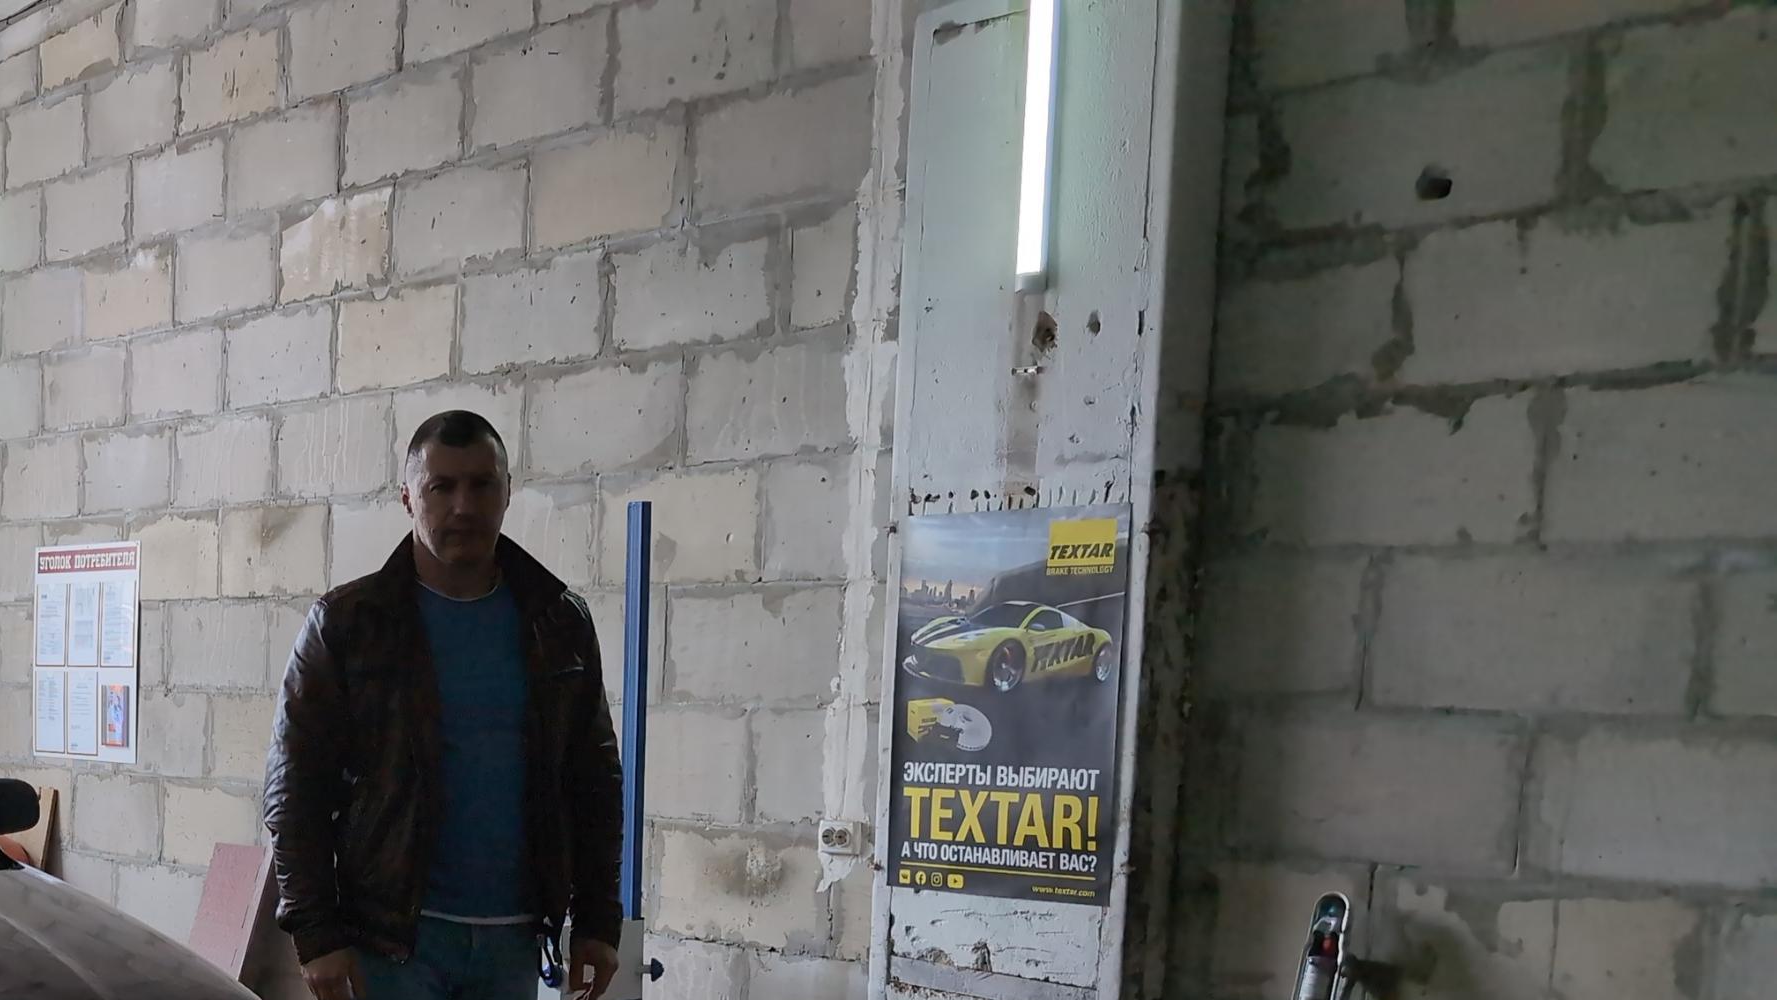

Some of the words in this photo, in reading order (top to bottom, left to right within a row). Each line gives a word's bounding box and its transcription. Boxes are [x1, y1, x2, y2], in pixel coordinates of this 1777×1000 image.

[39, 555, 72, 570] УГОЛОК
[74, 551, 136, 569] ПОТРЕБИТЕЛЯ
[1050, 543, 1114, 560] TEXTAR
[1046, 567, 1069, 576] BRAKE
[1031, 632, 1095, 672] TEXTAR
[903, 762, 991, 786] ЭКСПЕРТЫ
[996, 766, 1100, 791] ВЫБИРАЮТ
[903, 787, 1099, 851] TEXTAR!
[901, 842, 911, 858] А
[914, 843, 938, 860] ЧТО
[941, 845, 1056, 869] ОСТАНАВЛИВАЕТ
[1060, 853, 1097, 873] ВАС?
[1031, 885, 1096, 898] www.textar.com
